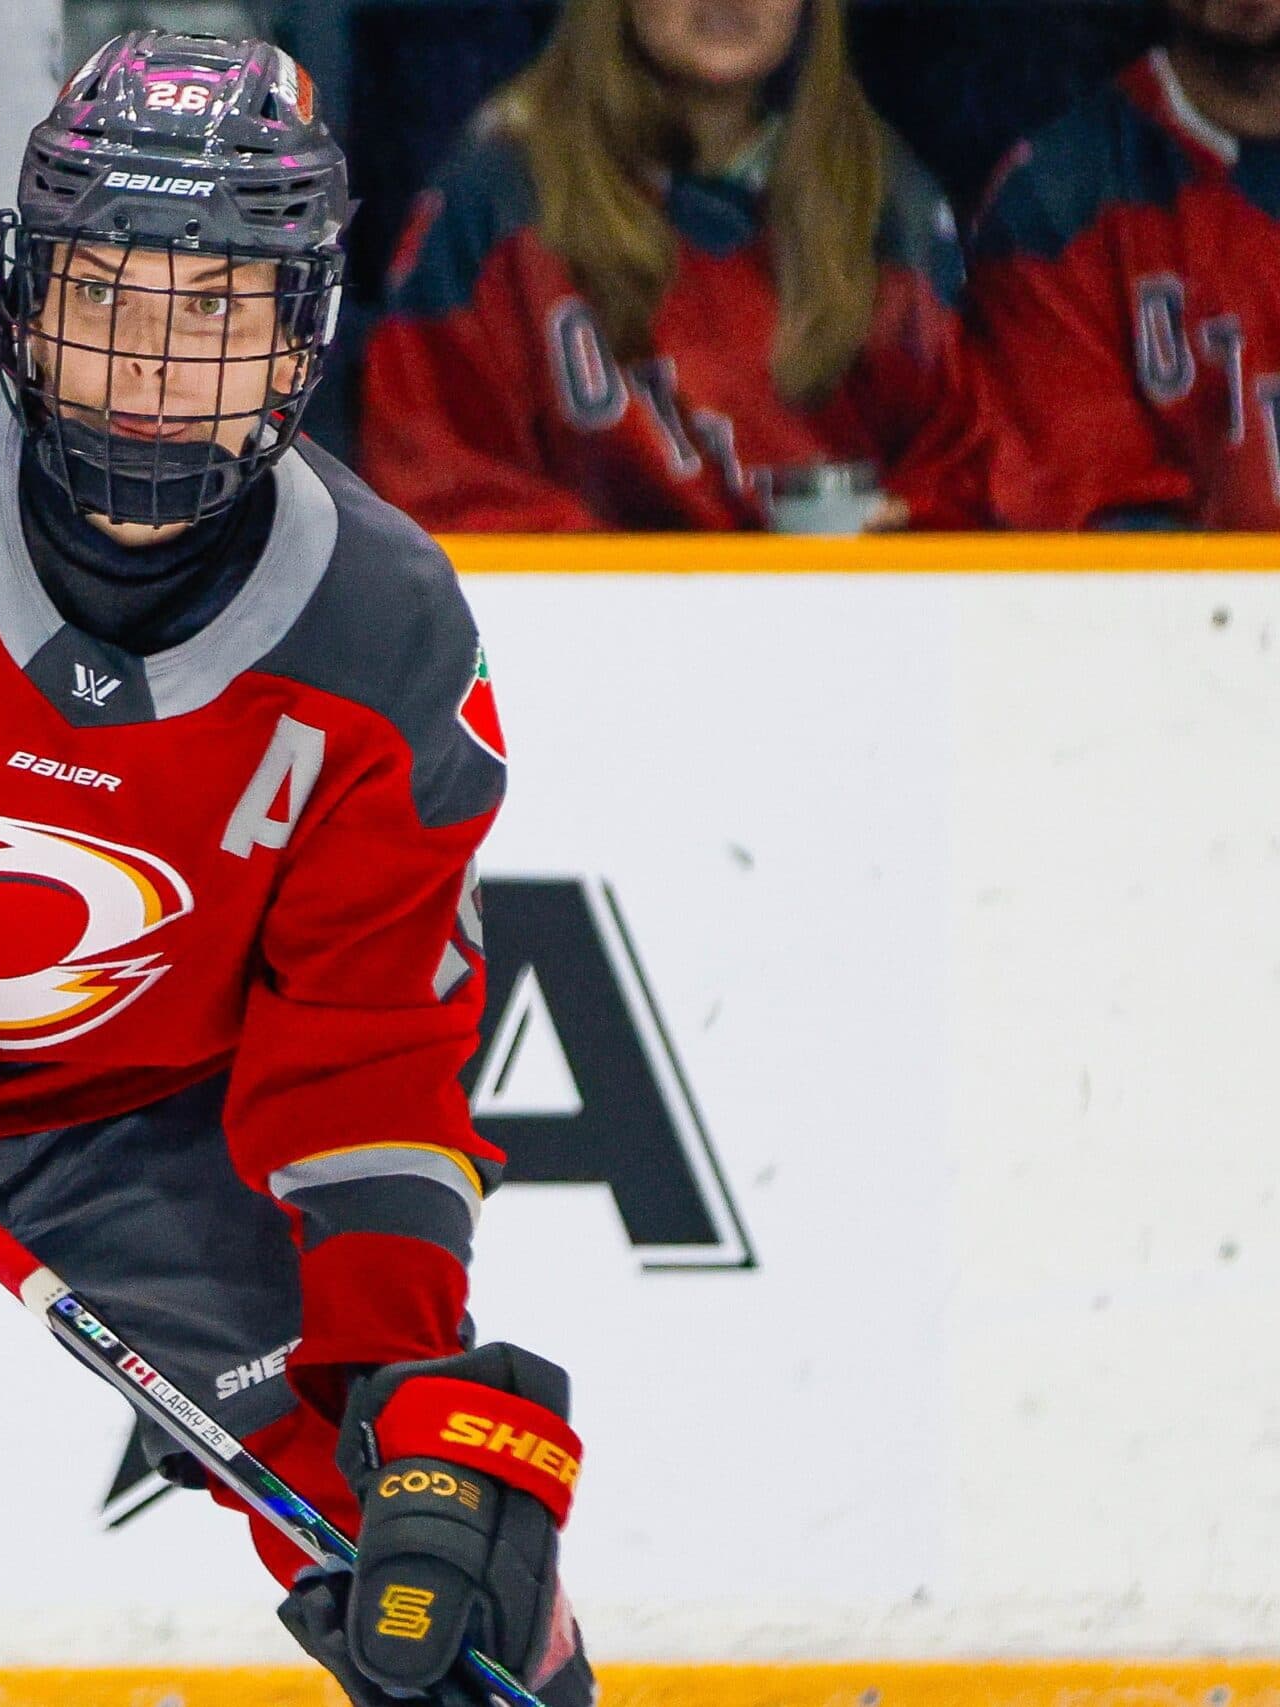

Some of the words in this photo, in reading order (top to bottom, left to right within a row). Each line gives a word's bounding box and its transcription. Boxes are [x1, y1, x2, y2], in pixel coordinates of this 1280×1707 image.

[145, 81, 216, 110] 26
[104, 170, 215, 198] BAUER
[7, 750, 122, 792] BAUER
[220, 713, 326, 859] A
[151, 1382, 204, 1428] CLARKY
[201, 1424, 226, 1446] 26
